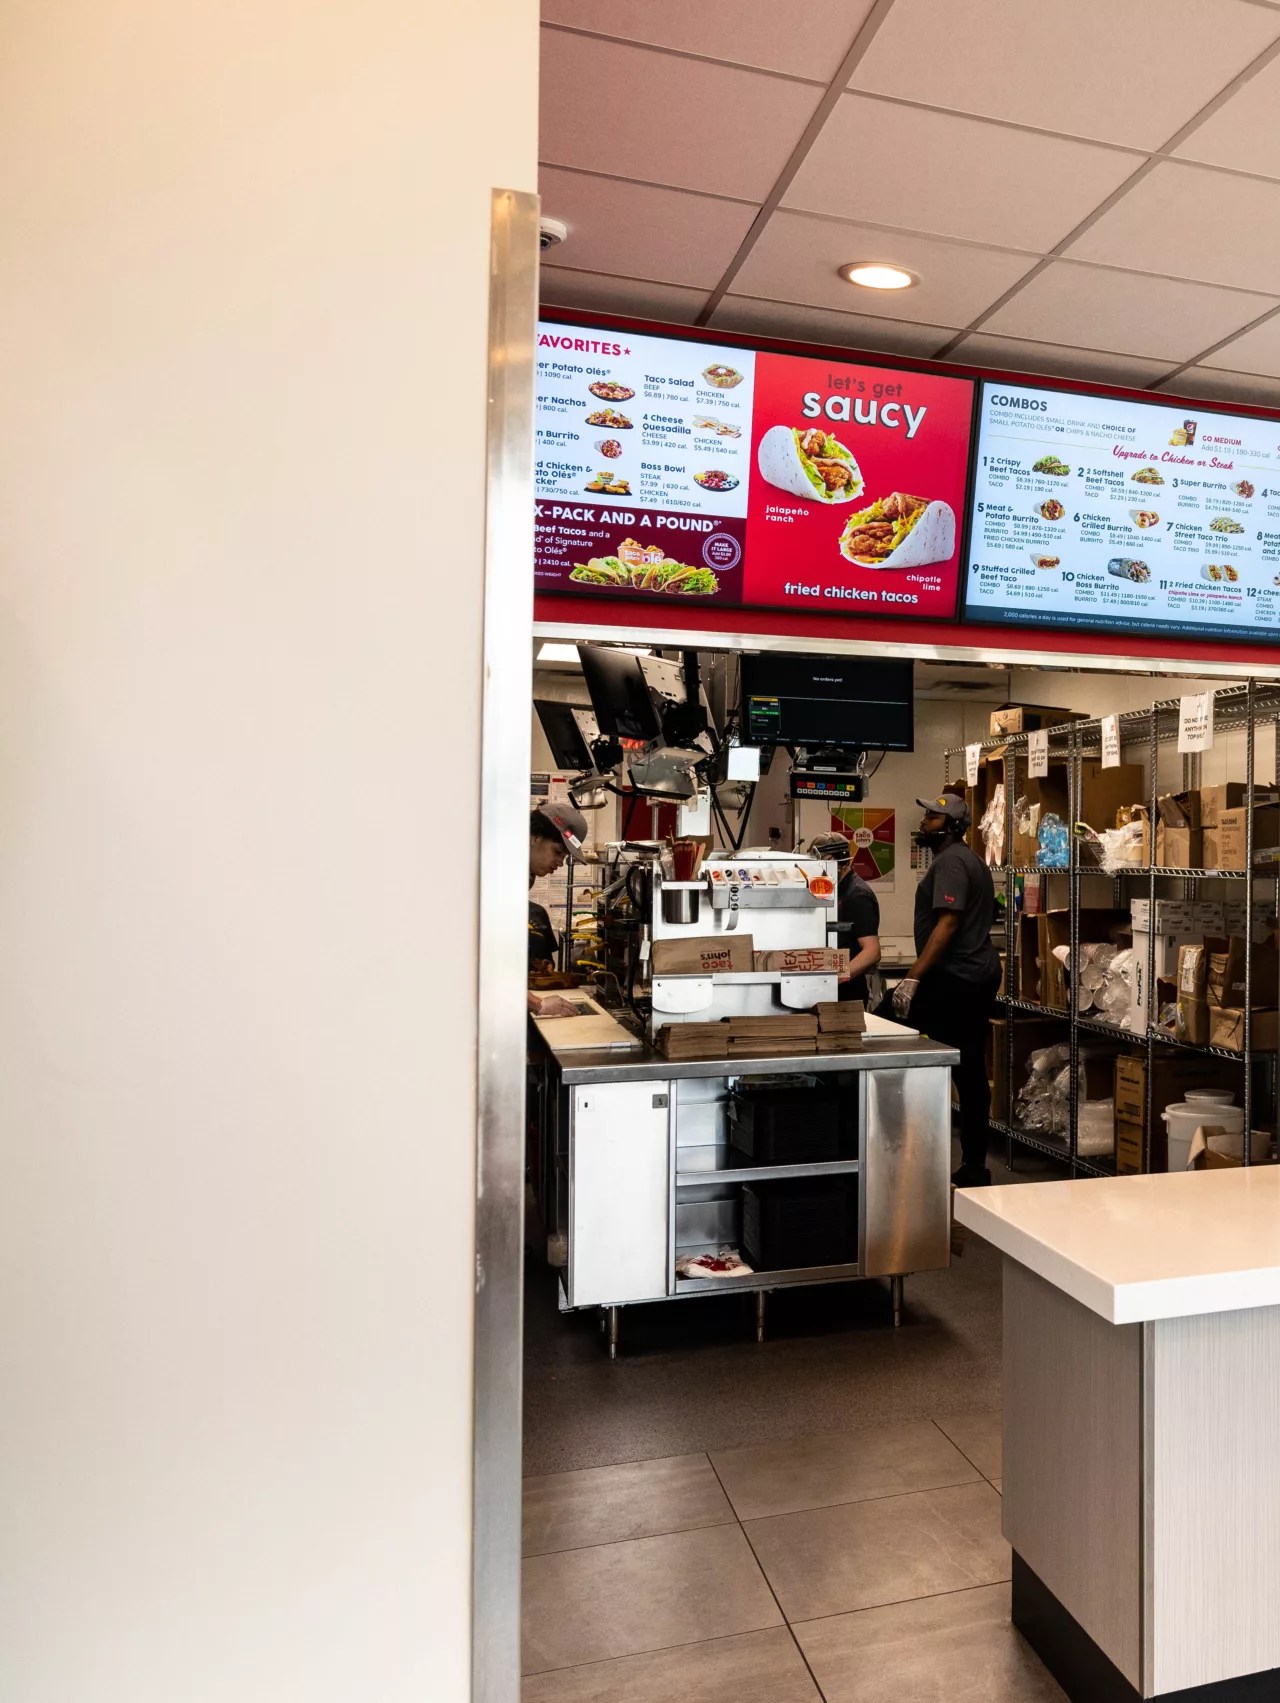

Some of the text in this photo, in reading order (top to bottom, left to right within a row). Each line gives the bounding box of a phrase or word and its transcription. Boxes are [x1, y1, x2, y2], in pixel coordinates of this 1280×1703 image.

[552, 363, 584, 374] Potato
[644, 375, 695, 388] Taco Salad
[827, 374, 902, 398] let's get
[696, 390, 724, 398] CHICKEN
[551, 396, 586, 407] Nachos
[991, 395, 1048, 411] COMBOS
[801, 391, 927, 439] saucy
[642, 423, 691, 435] Quesadilla
[546, 430, 580, 440] Burrito
[694, 438, 723, 446] CHICKEN
[1112, 445, 1147, 461] Upgrade
[1150, 452, 1158, 460] to
[1161, 452, 1194, 465] Chicken
[1208, 457, 1234, 470] Steak
[546, 462, 585, 472] Chicken
[641, 462, 686, 473] Boss Bowl
[990, 465, 1030, 476] Beef Tacos
[1086, 476, 1124, 486] Beef Tacos
[1172, 478, 1227, 490] 3 Super Burrito
[1261, 489, 1268, 498] 4
[766, 505, 809, 516] jalapeño
[600, 511, 635, 526] AND
[640, 514, 651, 526] A
[766, 514, 793, 523] ranch
[986, 512, 1039, 523] Potato Burrito
[1073, 513, 1110, 522] 6 Chicken
[535, 525, 557, 533] Beef
[559, 526, 586, 536] Tacos
[1082, 522, 1132, 532] Grilled Burrito
[1167, 522, 1202, 532] 7 Chicken
[1175, 531, 1196, 539] Street
[1257, 532, 1262, 540] 8
[972, 564, 1035, 576] 9 Stuffed Grilled
[906, 574, 942, 583] chipotle
[981, 574, 998, 582] Beef
[1062, 572, 1104, 582] 10 Chicken
[1094, 582, 1119, 591] Burrito
[784, 582, 918, 604] fried chicken tacos
[702, 960, 733, 970] taco
